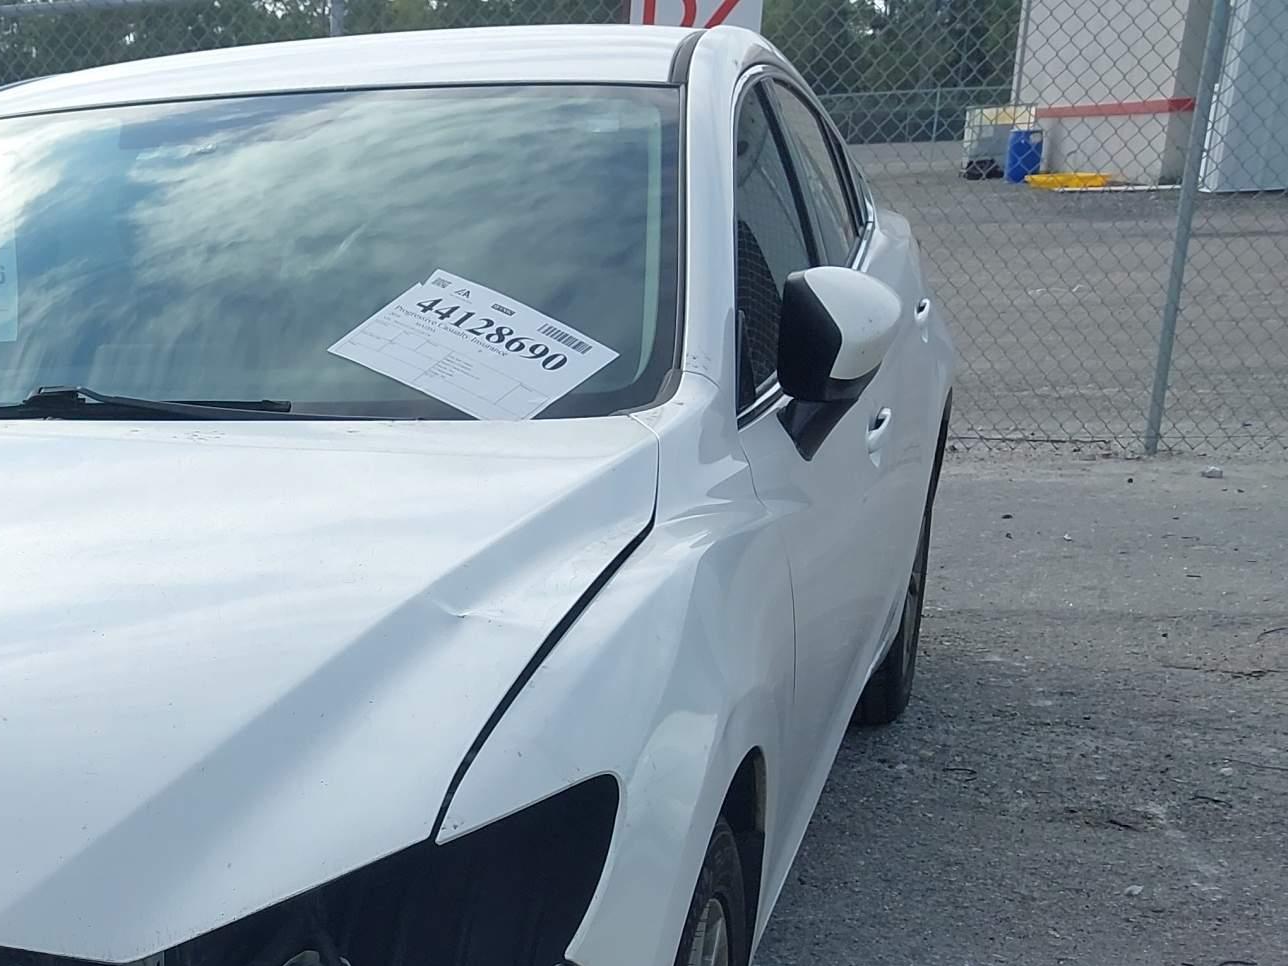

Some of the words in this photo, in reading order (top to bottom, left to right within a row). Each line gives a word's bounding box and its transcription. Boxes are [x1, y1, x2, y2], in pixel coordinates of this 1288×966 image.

[416, 298, 568, 371] 44128690
[438, 319, 469, 340] Casualty
[470, 336, 509, 357] Insurance
